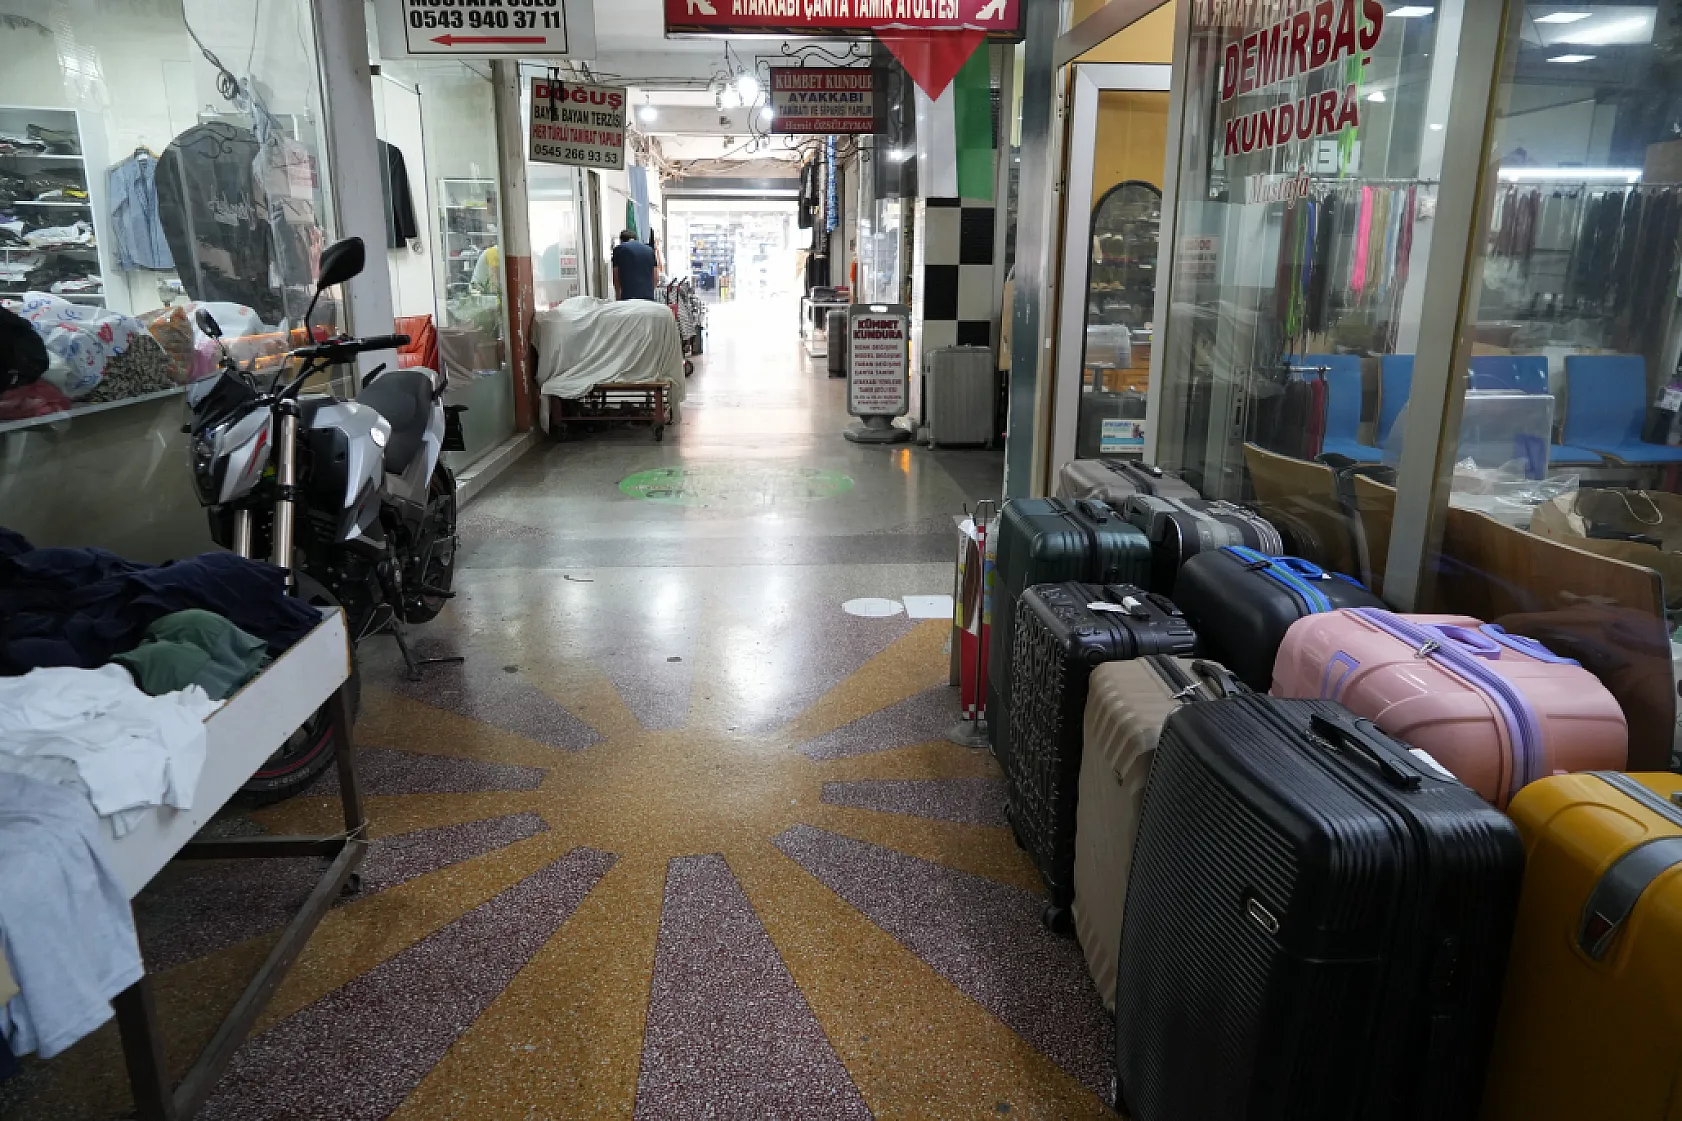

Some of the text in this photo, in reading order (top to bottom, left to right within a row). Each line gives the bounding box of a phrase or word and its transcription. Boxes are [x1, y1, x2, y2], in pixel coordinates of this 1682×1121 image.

[410, 10, 560, 28] 0543 940 37 11
[775, 71, 874, 89] KÜMBET KUNDUR
[535, 85, 622, 110] DOĞUŞ
[789, 92, 864, 103] AYAKKABI
[1224, 83, 1360, 157] KUNDURA
[534, 144, 562, 158] 0545
[565, 148, 585, 161] 266
[588, 150, 601, 163] 93
[857, 318, 899, 329] KÜMBET
[853, 330, 903, 340] KUNDURA
